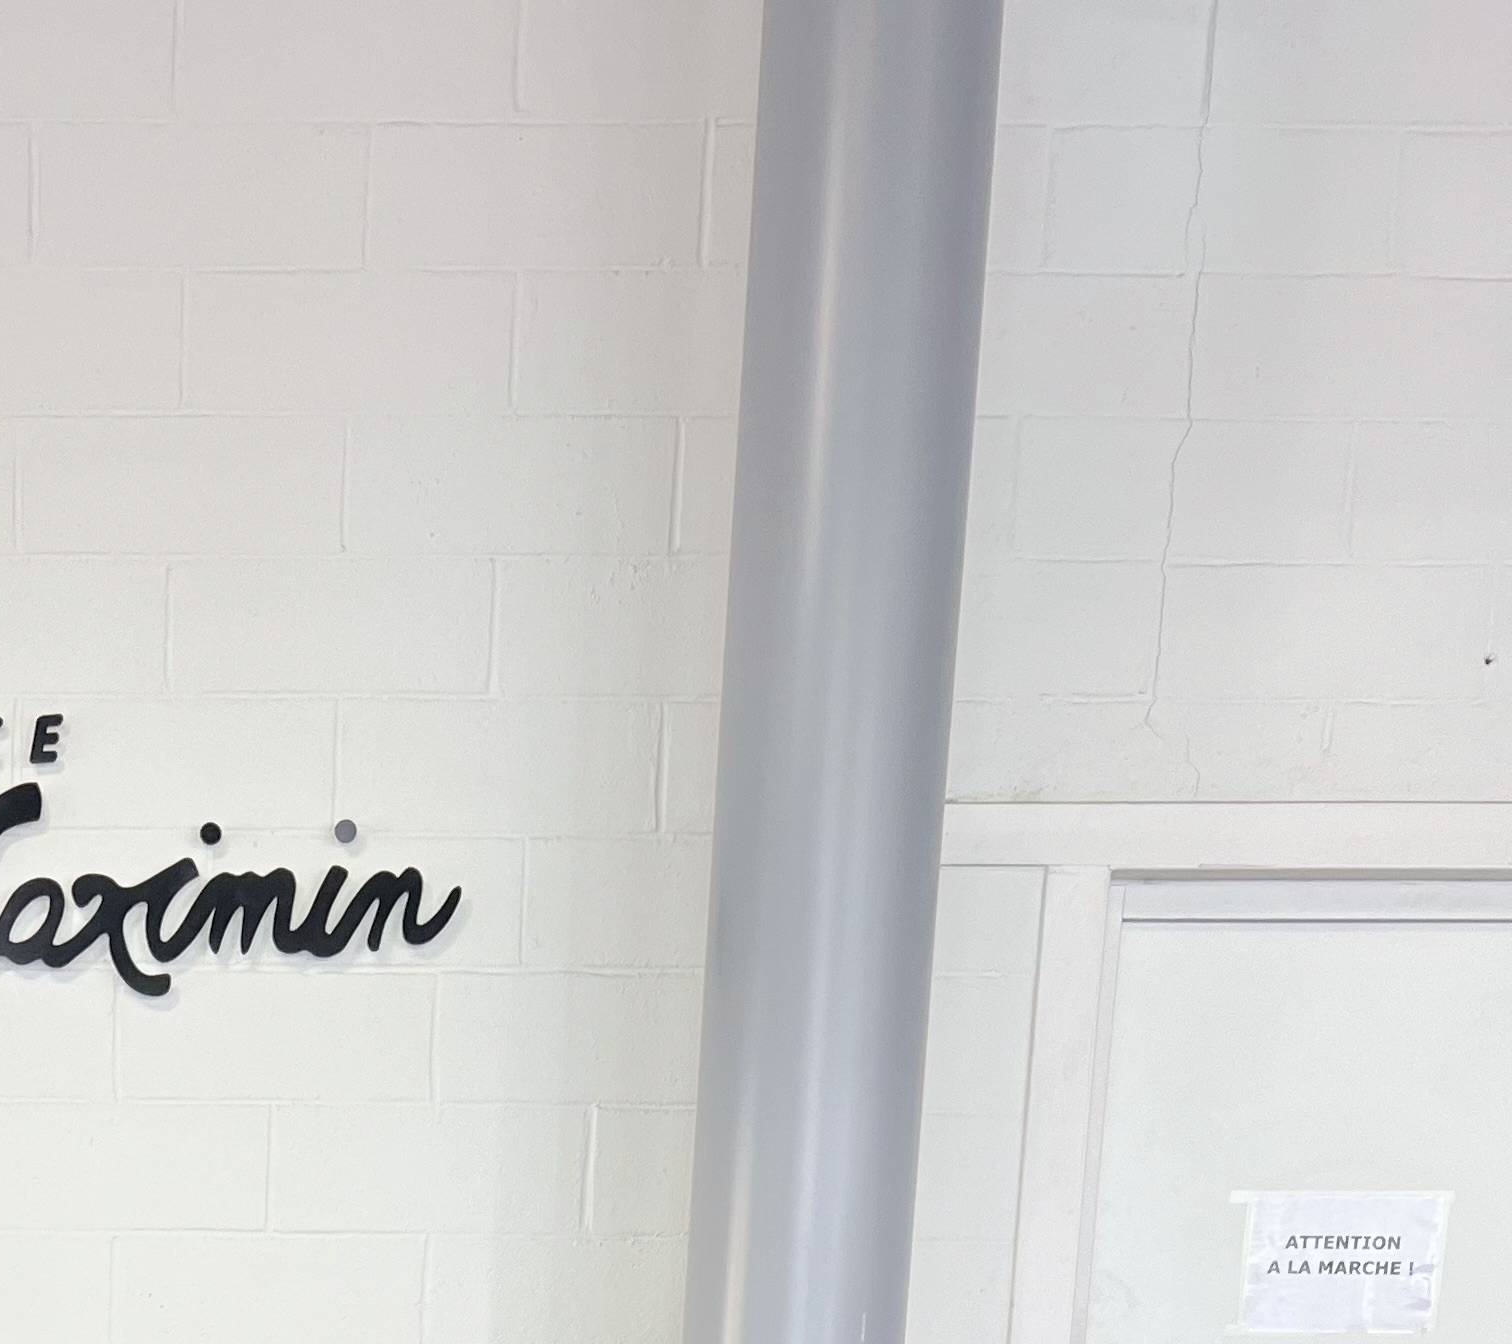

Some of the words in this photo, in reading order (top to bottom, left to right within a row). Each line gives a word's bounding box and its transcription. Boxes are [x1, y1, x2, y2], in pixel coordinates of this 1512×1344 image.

[1285, 1235, 1402, 1250] ATTENTION
[1267, 1260, 1280, 1275] A
[1288, 1260, 1311, 1275] LA
[1318, 1260, 1402, 1276] MARCHE
